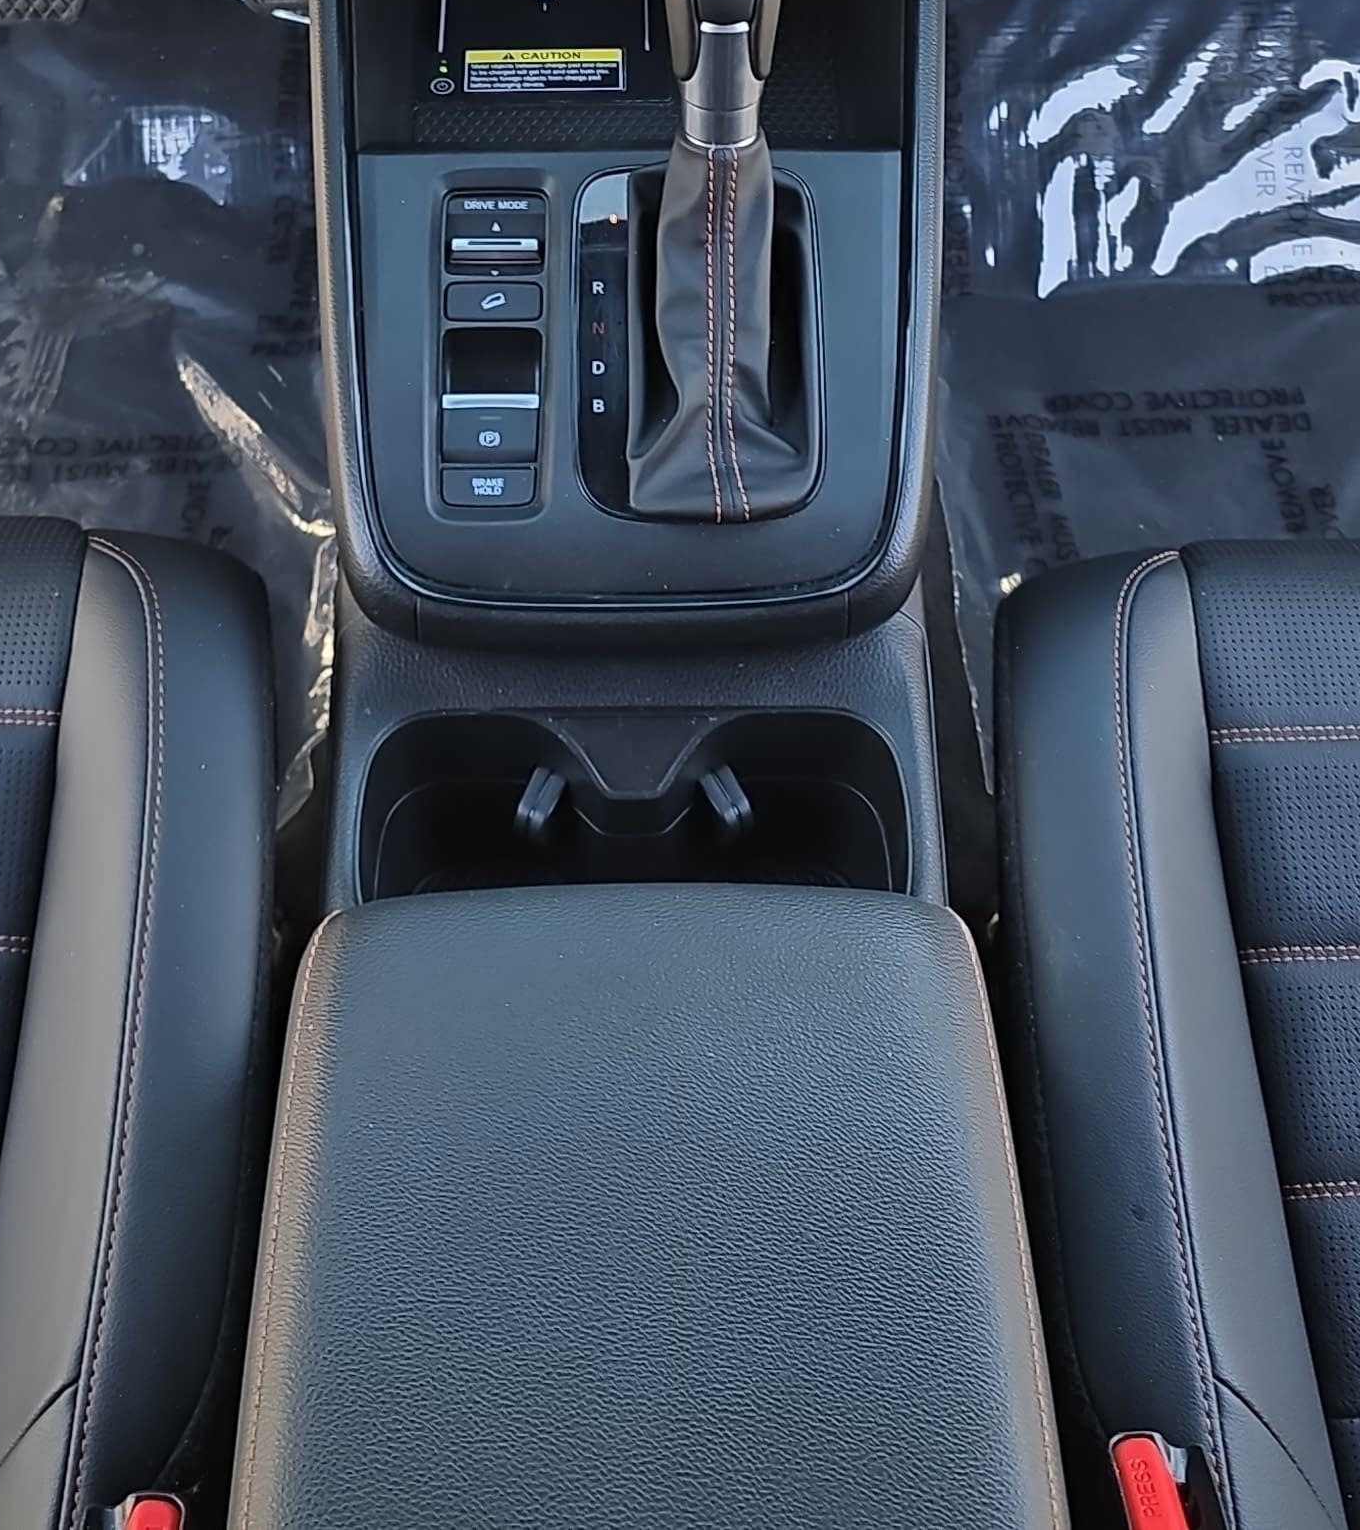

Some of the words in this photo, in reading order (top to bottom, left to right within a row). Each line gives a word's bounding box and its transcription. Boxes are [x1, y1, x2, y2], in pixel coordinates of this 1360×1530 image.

[520, 52, 581, 60] CAUTION
[464, 200, 494, 211] DRIVE
[498, 200, 529, 211] MODE
[592, 281, 605, 295] R
[592, 322, 605, 336] N
[592, 361, 606, 375] D
[592, 399, 605, 413] B
[1143, 386, 1307, 411] PROTECTIVE
[1120, 416, 1193, 437] MUST
[1212, 412, 1312, 436] DEALER
[88, 432, 218, 457] OTECTIVE
[472, 478, 504, 487] BRAKE
[1260, 437, 1309, 535] REMOVE
[474, 487, 503, 496] HOLD
[1308, 483, 1346, 544] OVER
[1050, 512, 1080, 562] MUS
[1130, 1458, 1162, 1518] PRESS
